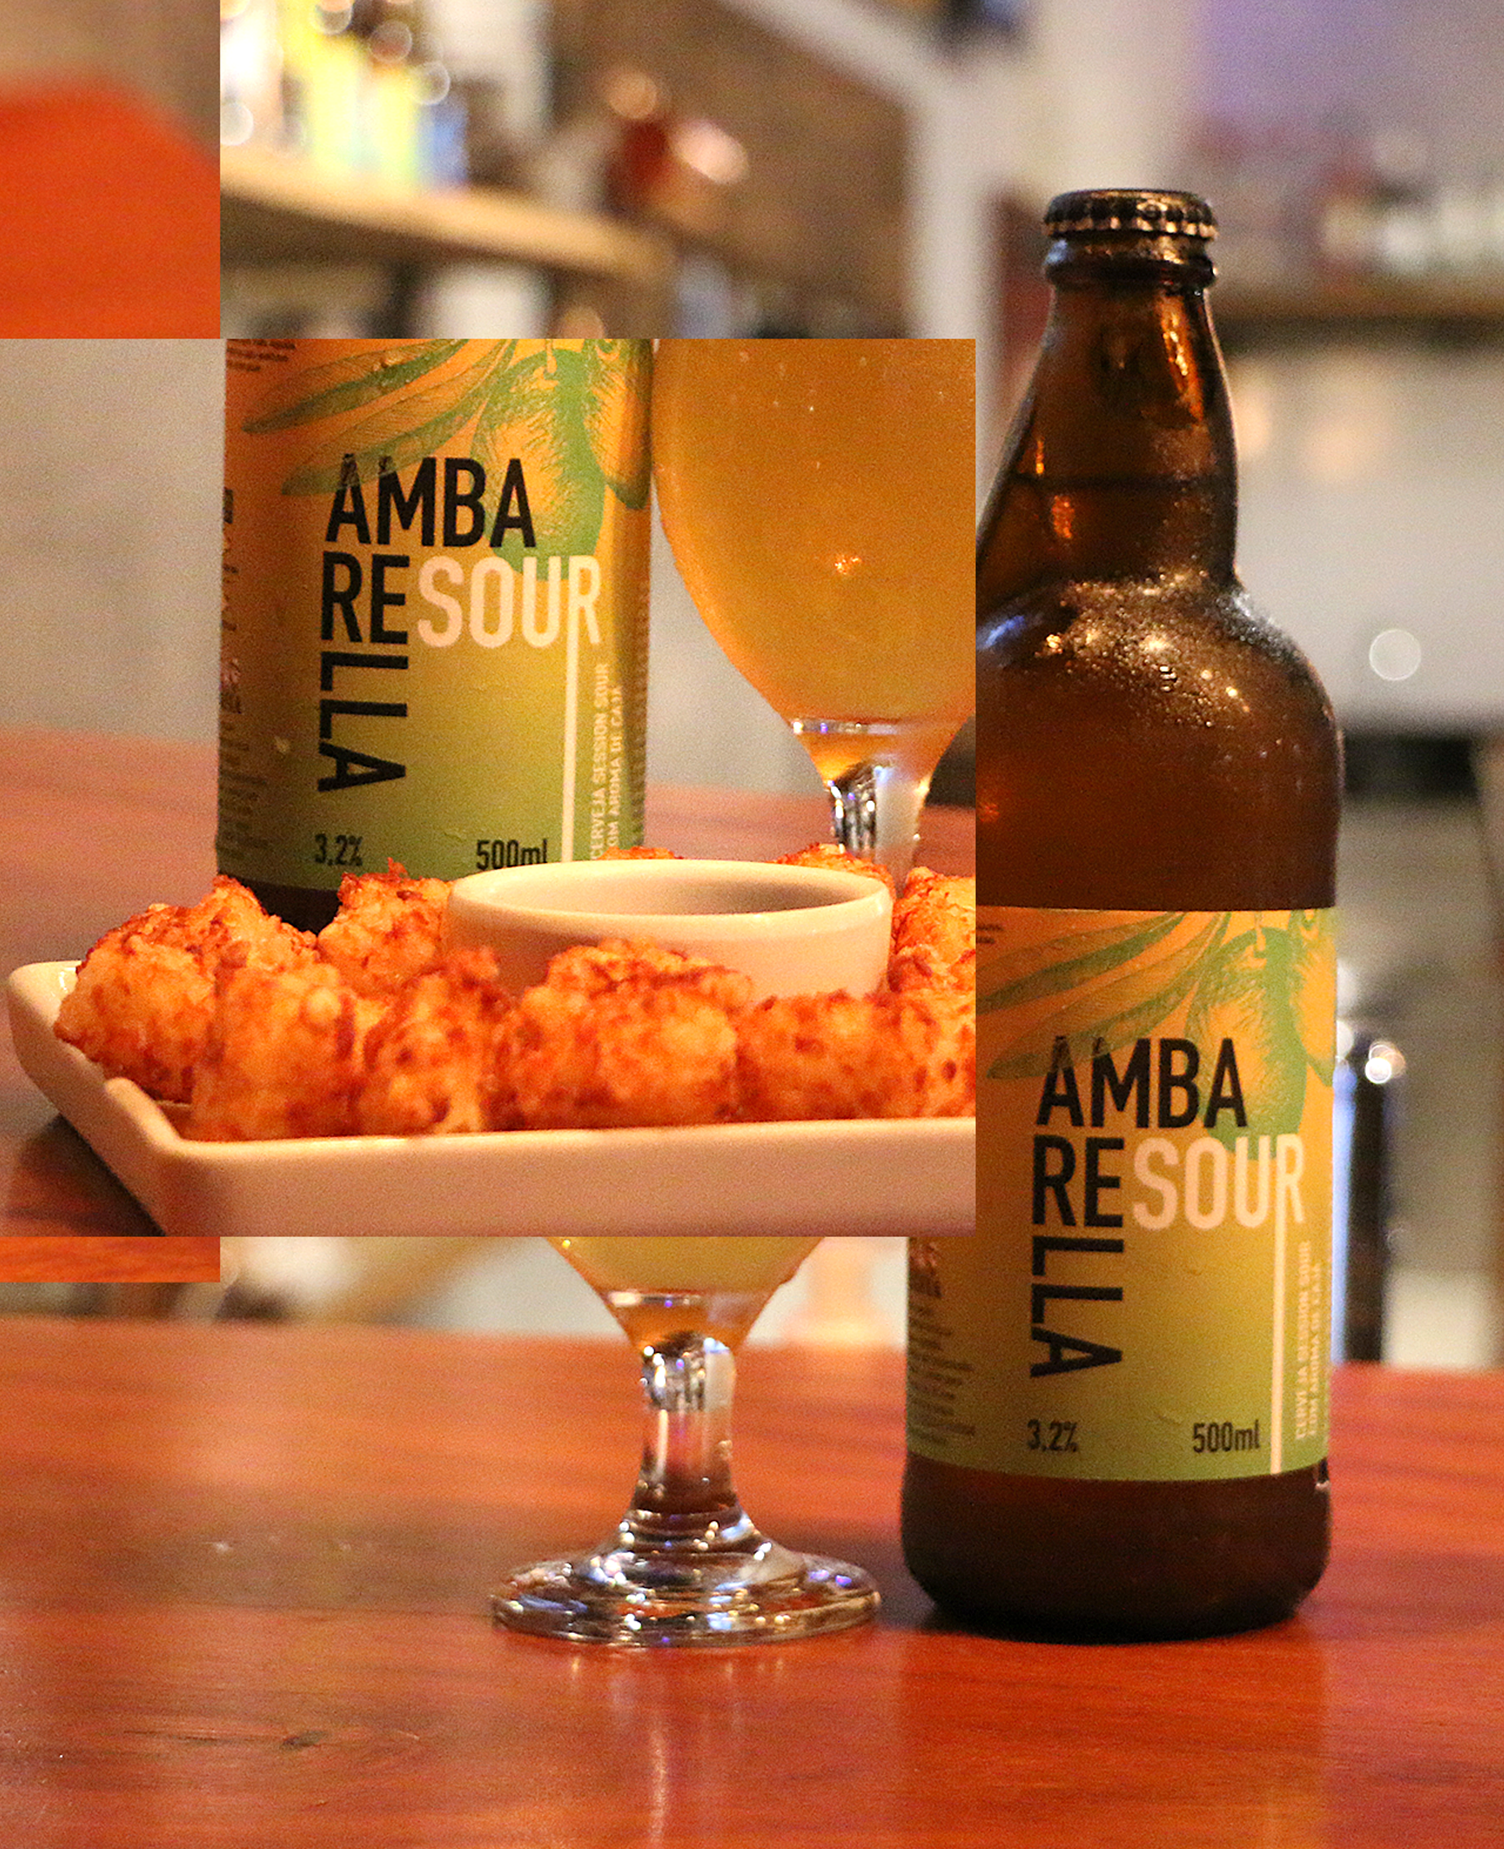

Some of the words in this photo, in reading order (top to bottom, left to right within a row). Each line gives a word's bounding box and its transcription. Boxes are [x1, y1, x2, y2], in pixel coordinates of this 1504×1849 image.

[325, 453, 537, 548] AMBA
[594, 664, 609, 708] SOUR
[607, 820, 619, 847] OM
[475, 838, 548, 871] 500ml
[1036, 1036, 1247, 1129] AMBA
[1192, 1419, 1260, 1453] 500ml
